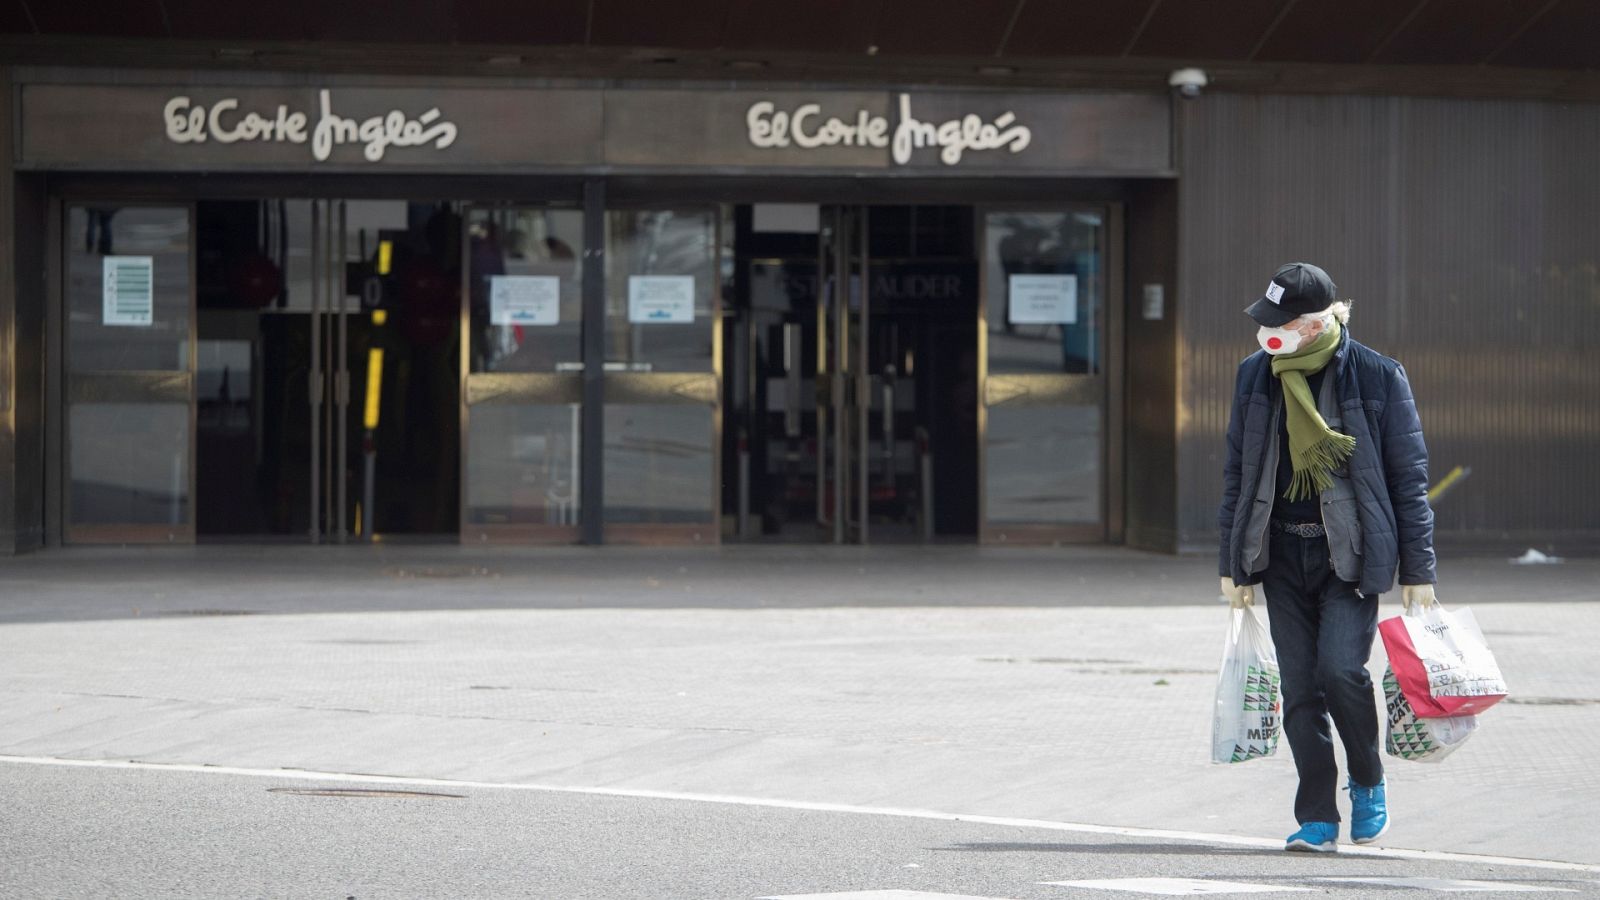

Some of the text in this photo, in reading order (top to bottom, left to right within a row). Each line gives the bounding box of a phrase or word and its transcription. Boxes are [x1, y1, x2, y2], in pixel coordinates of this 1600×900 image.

[164, 89, 457, 162] El Corte Inglés
[747, 93, 1032, 165] El Corte Inglés
